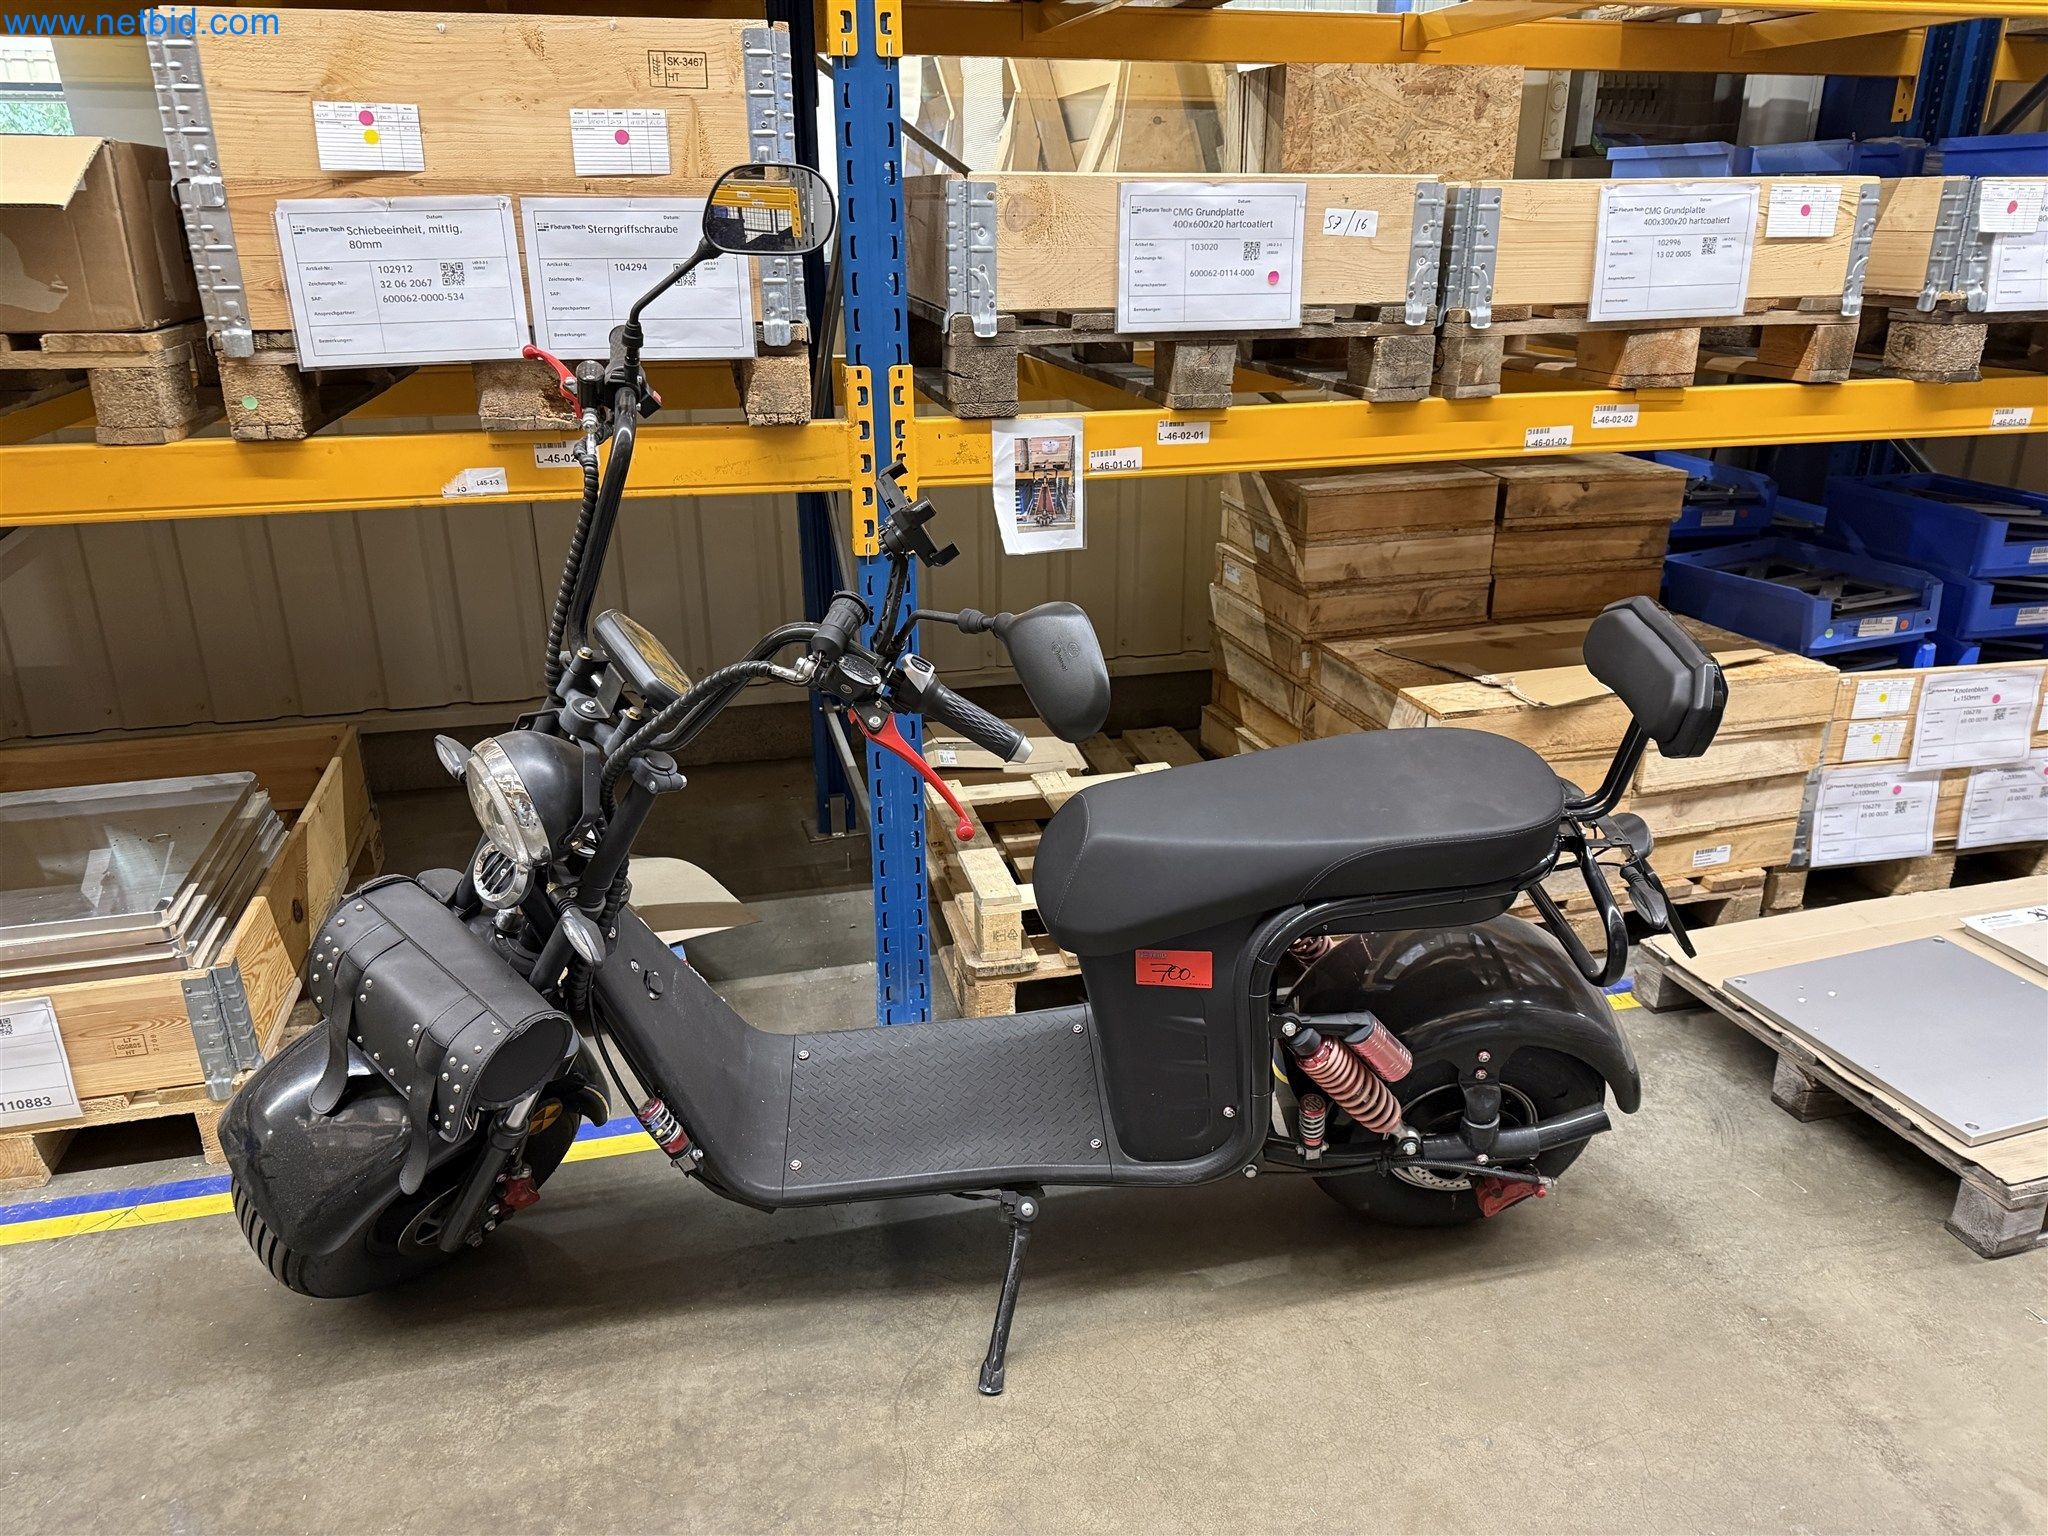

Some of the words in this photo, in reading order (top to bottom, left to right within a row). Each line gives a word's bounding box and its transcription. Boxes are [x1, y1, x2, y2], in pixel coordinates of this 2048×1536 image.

[667, 56, 704, 67] SK-3467
[668, 72, 680, 82] HT
[1173, 208, 1194, 217] CMG
[1196, 207, 1245, 218] Grundplatte
[1644, 206, 1662, 215] CMG
[1663, 206, 1706, 215] Grundplatte
[1173, 220, 1224, 229] 400x600x20
[1226, 220, 1273, 229] hartcoatiert
[1643, 217, 1687, 226] 400x300x20
[1688, 216, 1730, 225] hartcoatiert
[346, 224, 426, 236] Schiebeeinheit,
[587, 224, 679, 236] Sterngriffschraube
[349, 240, 383, 250] 80mm
[1191, 243, 1219, 251] 103020
[1675, 250, 1692, 258] 0005
[378, 264, 414, 274] 102912
[614, 263, 648, 272] 104294
[1189, 268, 1255, 277] 600062-0114-000
[380, 280, 393, 289] 32
[394, 279, 407, 288] 06
[410, 278, 433, 288] 2067
[382, 292, 465, 303] 600062-0000-534
[1592, 415, 1634, 424] L-46-02-02
[1158, 431, 1204, 441] L-46-02-01
[1525, 437, 1568, 448] L-46-01-02
